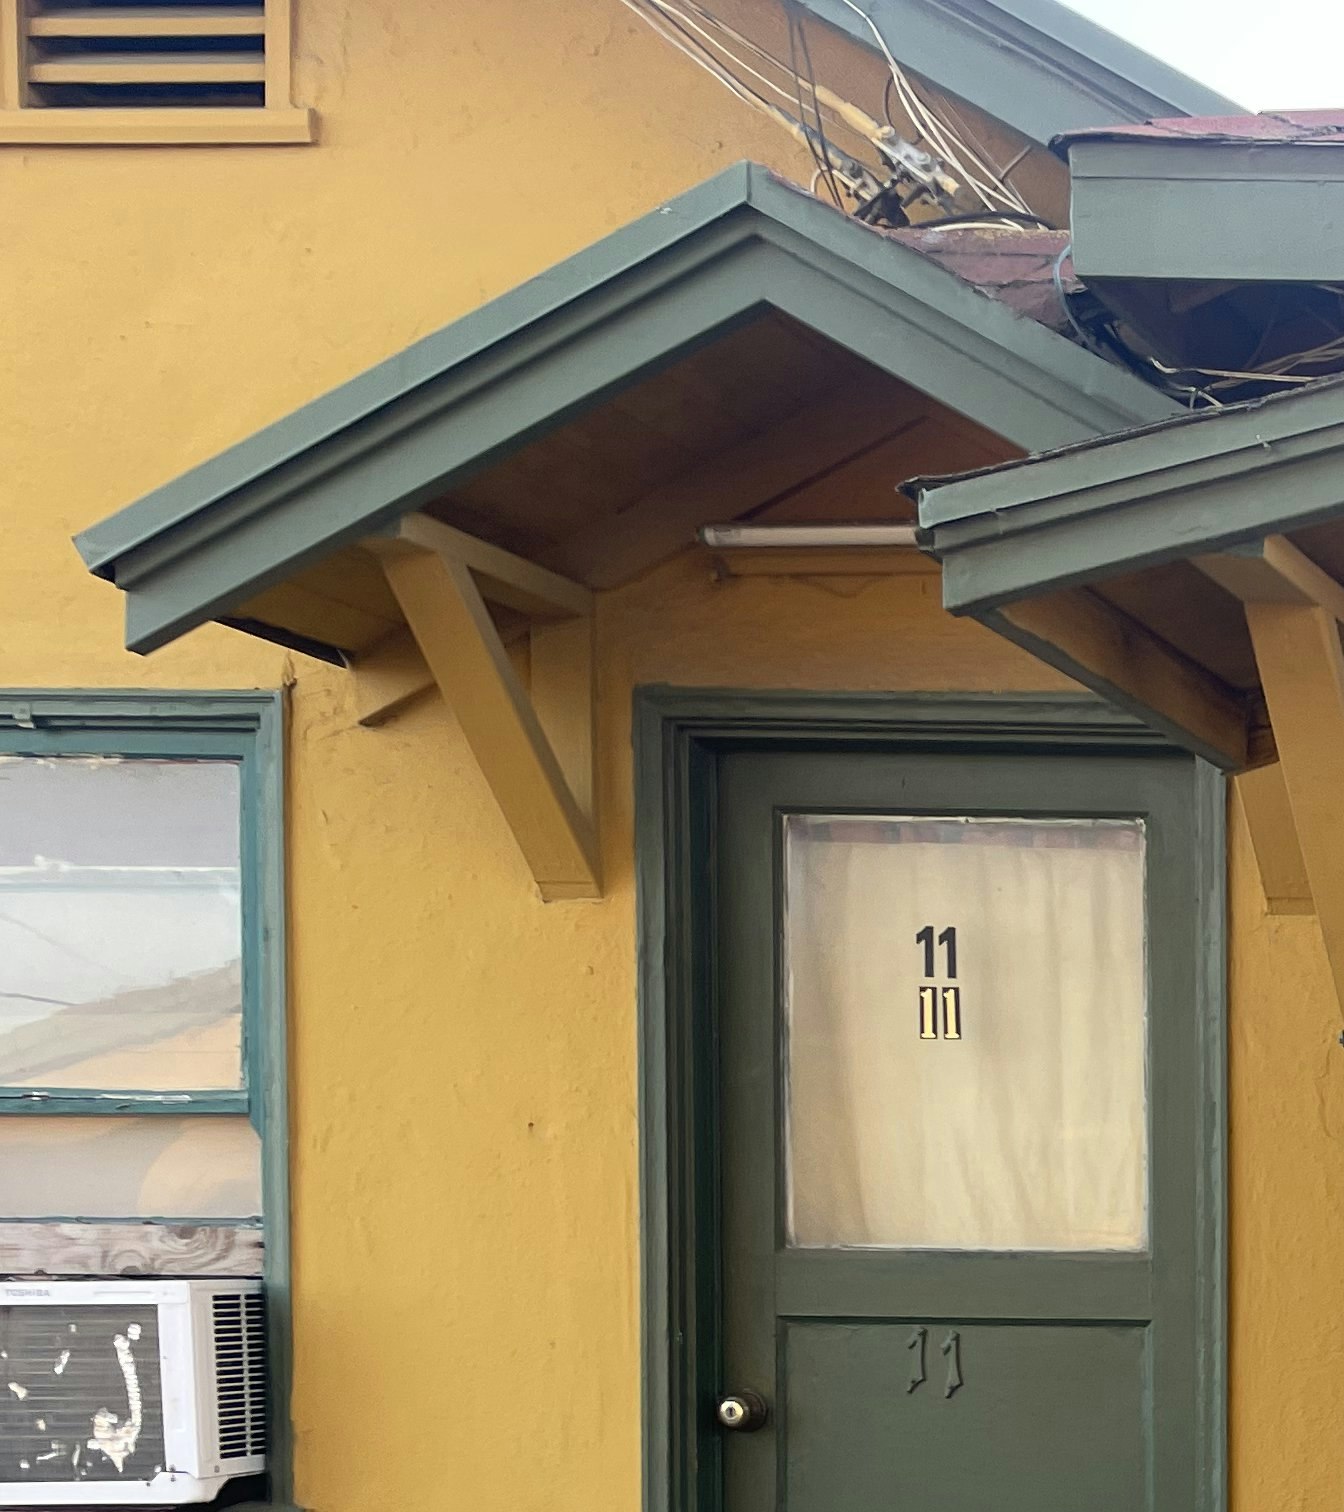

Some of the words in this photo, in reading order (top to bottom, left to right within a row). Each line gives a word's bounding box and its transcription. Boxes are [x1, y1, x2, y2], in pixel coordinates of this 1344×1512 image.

[916, 926, 957, 978] 11
[920, 987, 961, 1040] 11
[5, 1289, 50, 1297] TOSHIBA
